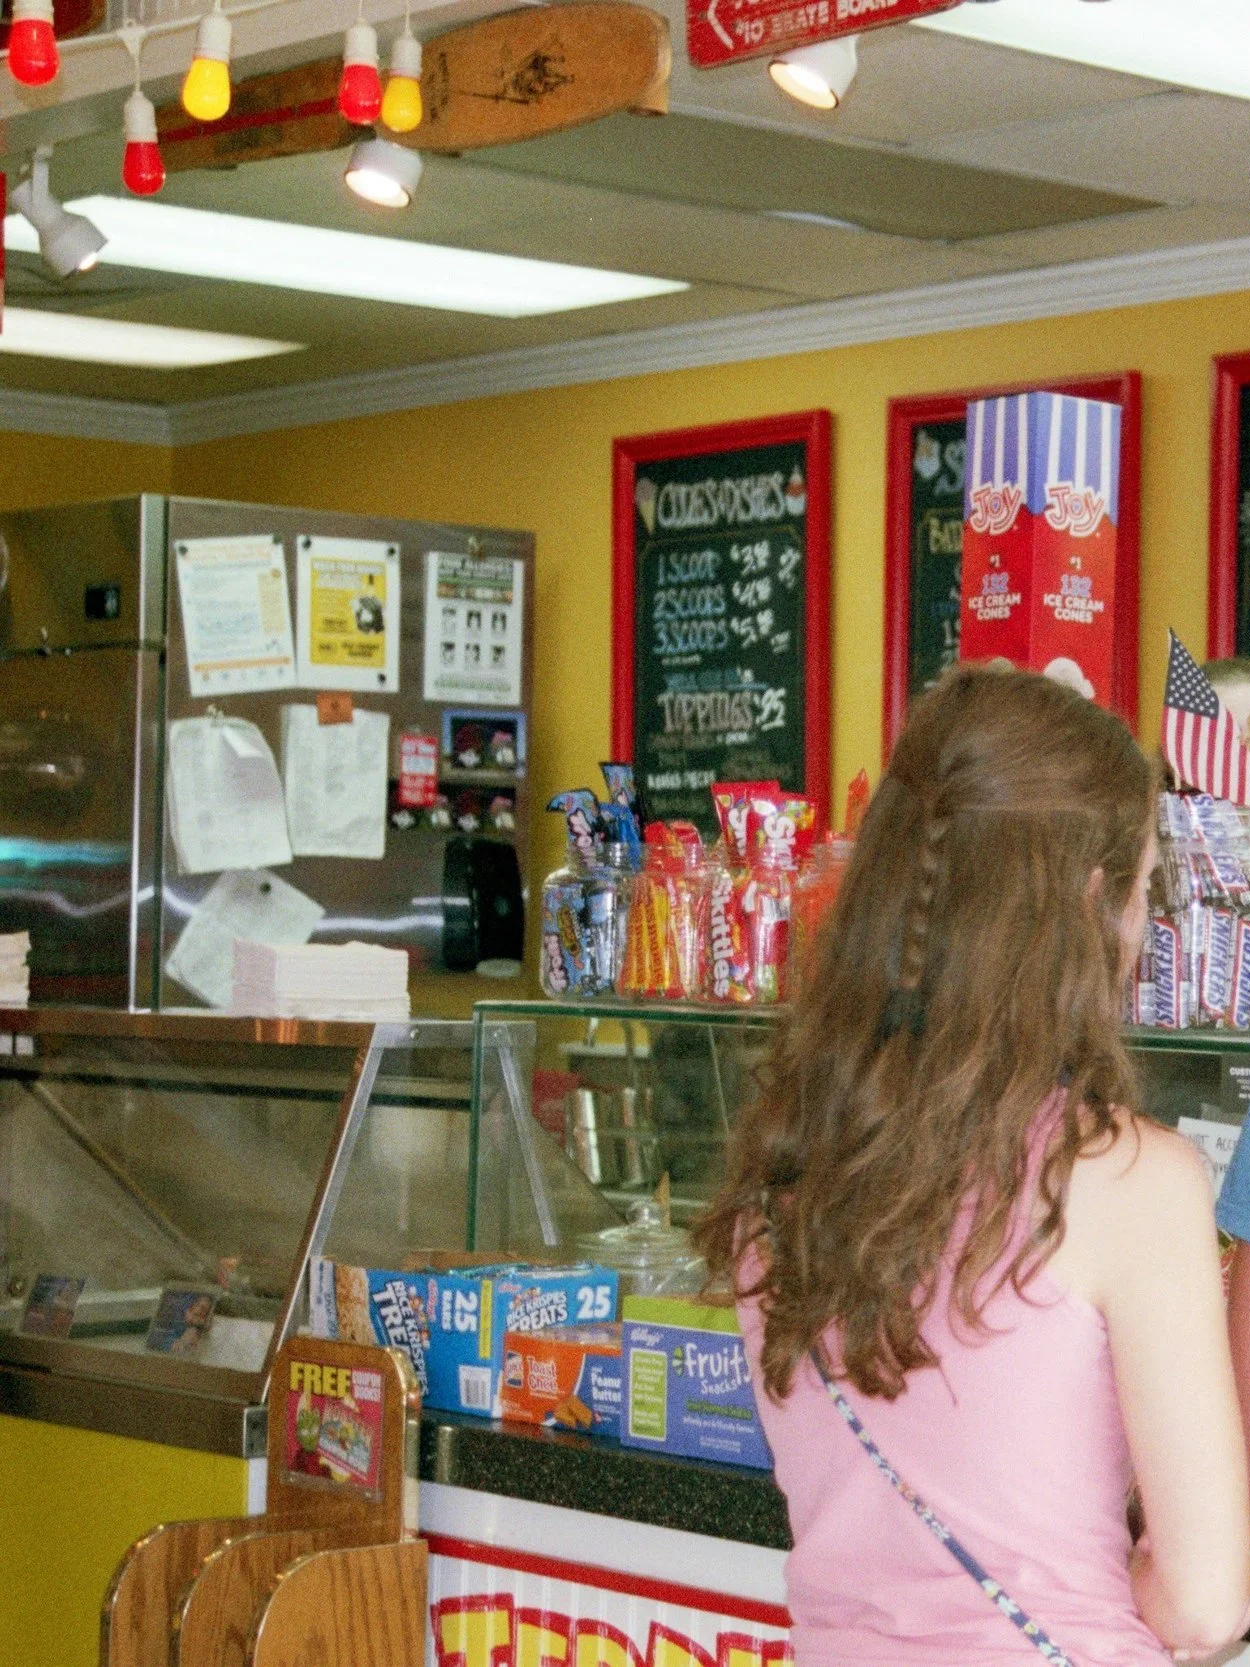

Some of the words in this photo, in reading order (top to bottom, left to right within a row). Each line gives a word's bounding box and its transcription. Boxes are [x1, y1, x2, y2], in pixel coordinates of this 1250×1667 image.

[968, 596, 985, 610] ICE
[985, 592, 1021, 608] CREAM
[1043, 593, 1062, 608] ICE
[1062, 596, 1105, 613] CREAM
[976, 606, 1011, 621] CONES
[1053, 608, 1094, 624] CONES
[1152, 918, 1176, 1026] SNICKERS
[576, 1285, 612, 1319] 25
[289, 1361, 352, 1399] FREE
